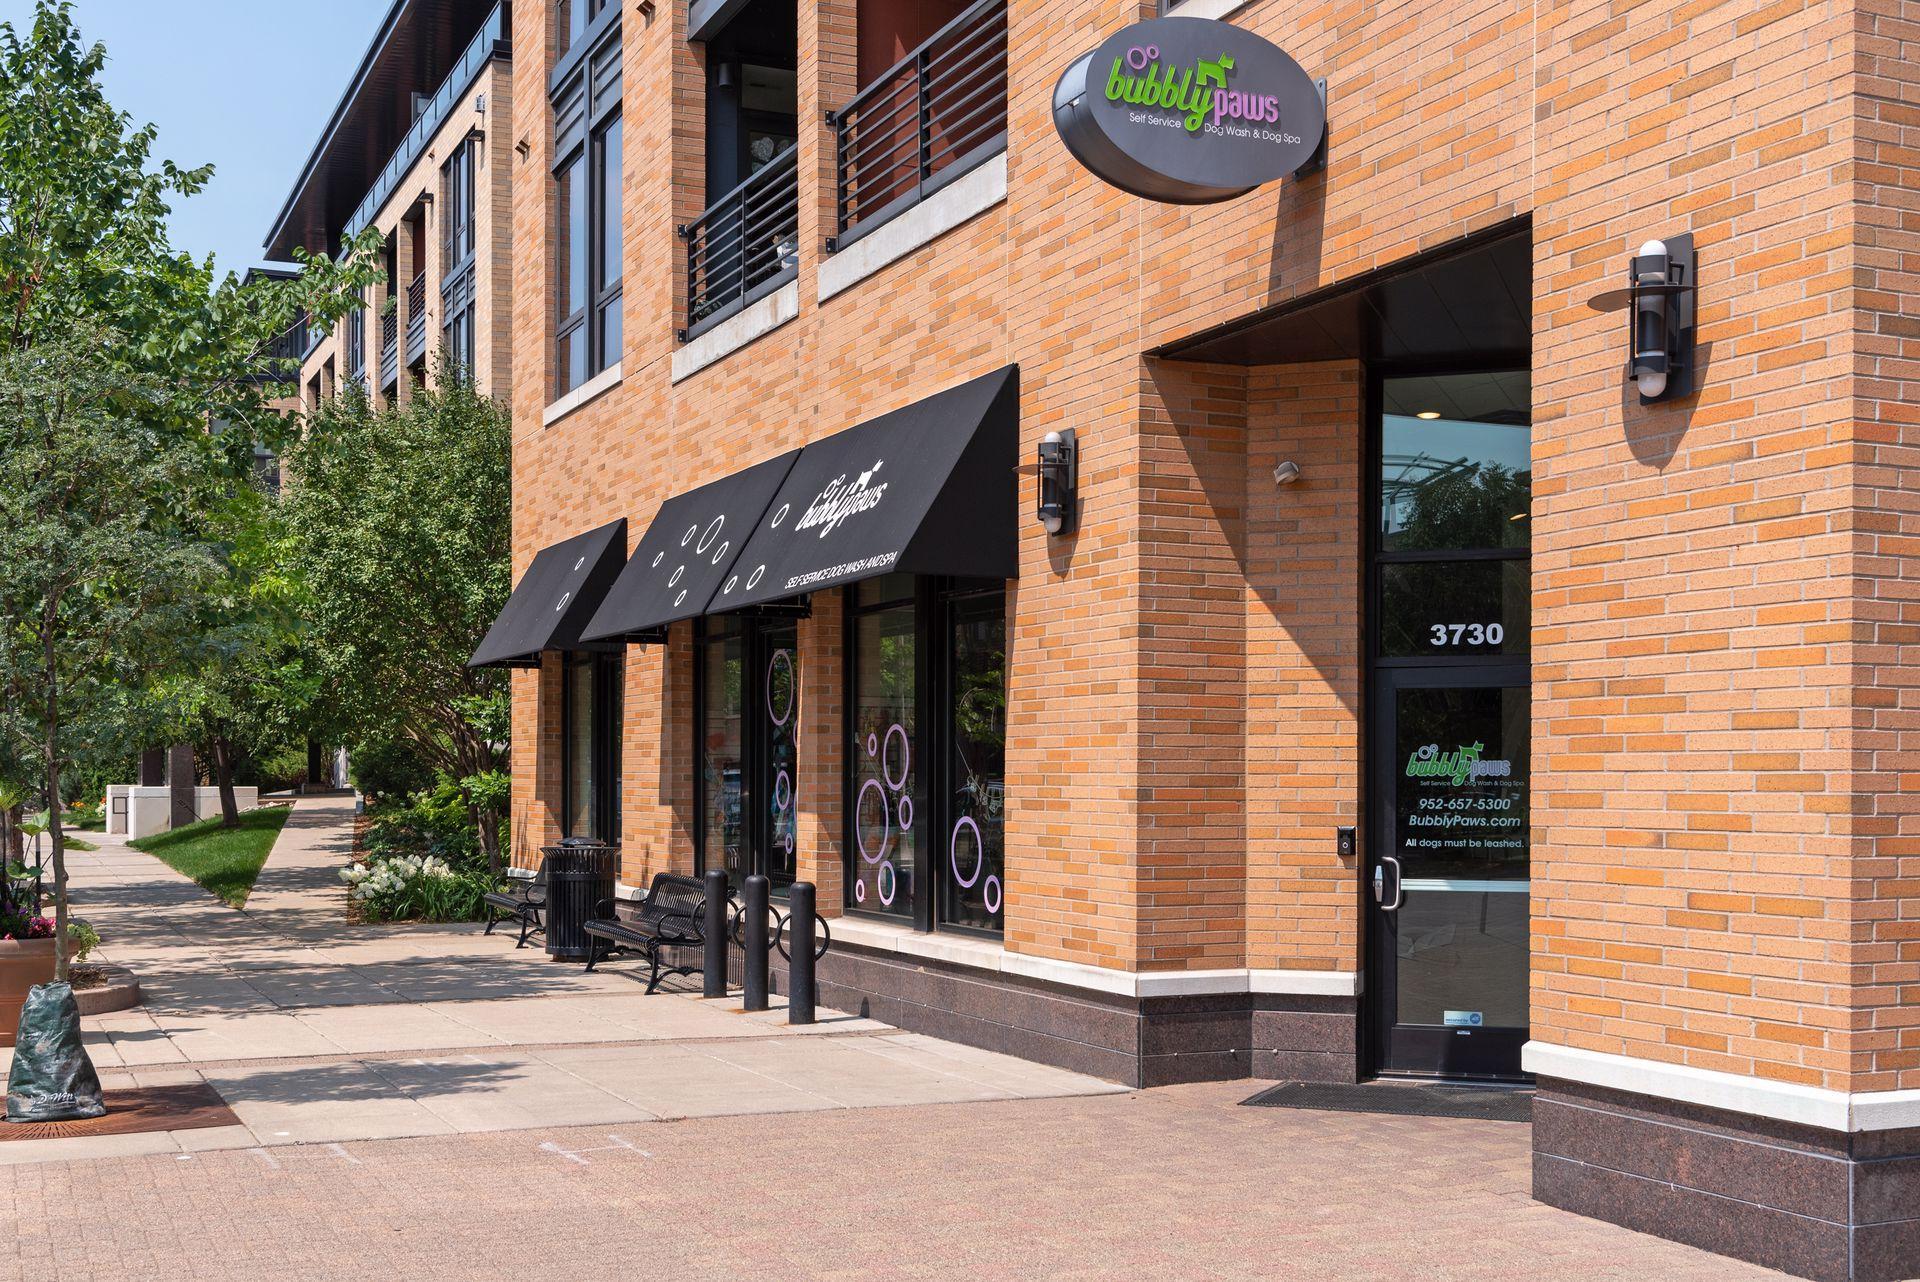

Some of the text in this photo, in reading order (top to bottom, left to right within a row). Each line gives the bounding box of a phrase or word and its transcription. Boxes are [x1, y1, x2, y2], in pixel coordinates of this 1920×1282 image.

[1129, 112, 1301, 145] Self Service Dog Wash & Dog Spa
[785, 551, 898, 589] SELF SERVICE DOG WASH AND SPA
[1430, 623, 1503, 645] 3730
[1464, 780, 1477, 788] Dog
[1499, 780, 1512, 788] Dog
[1512, 780, 1524, 788] Spa
[1419, 798, 1511, 810] 952-657-5300
[1408, 815, 1521, 828] BubblyPaws.com
[1405, 838, 1525, 849] All dogs must be leashed.
